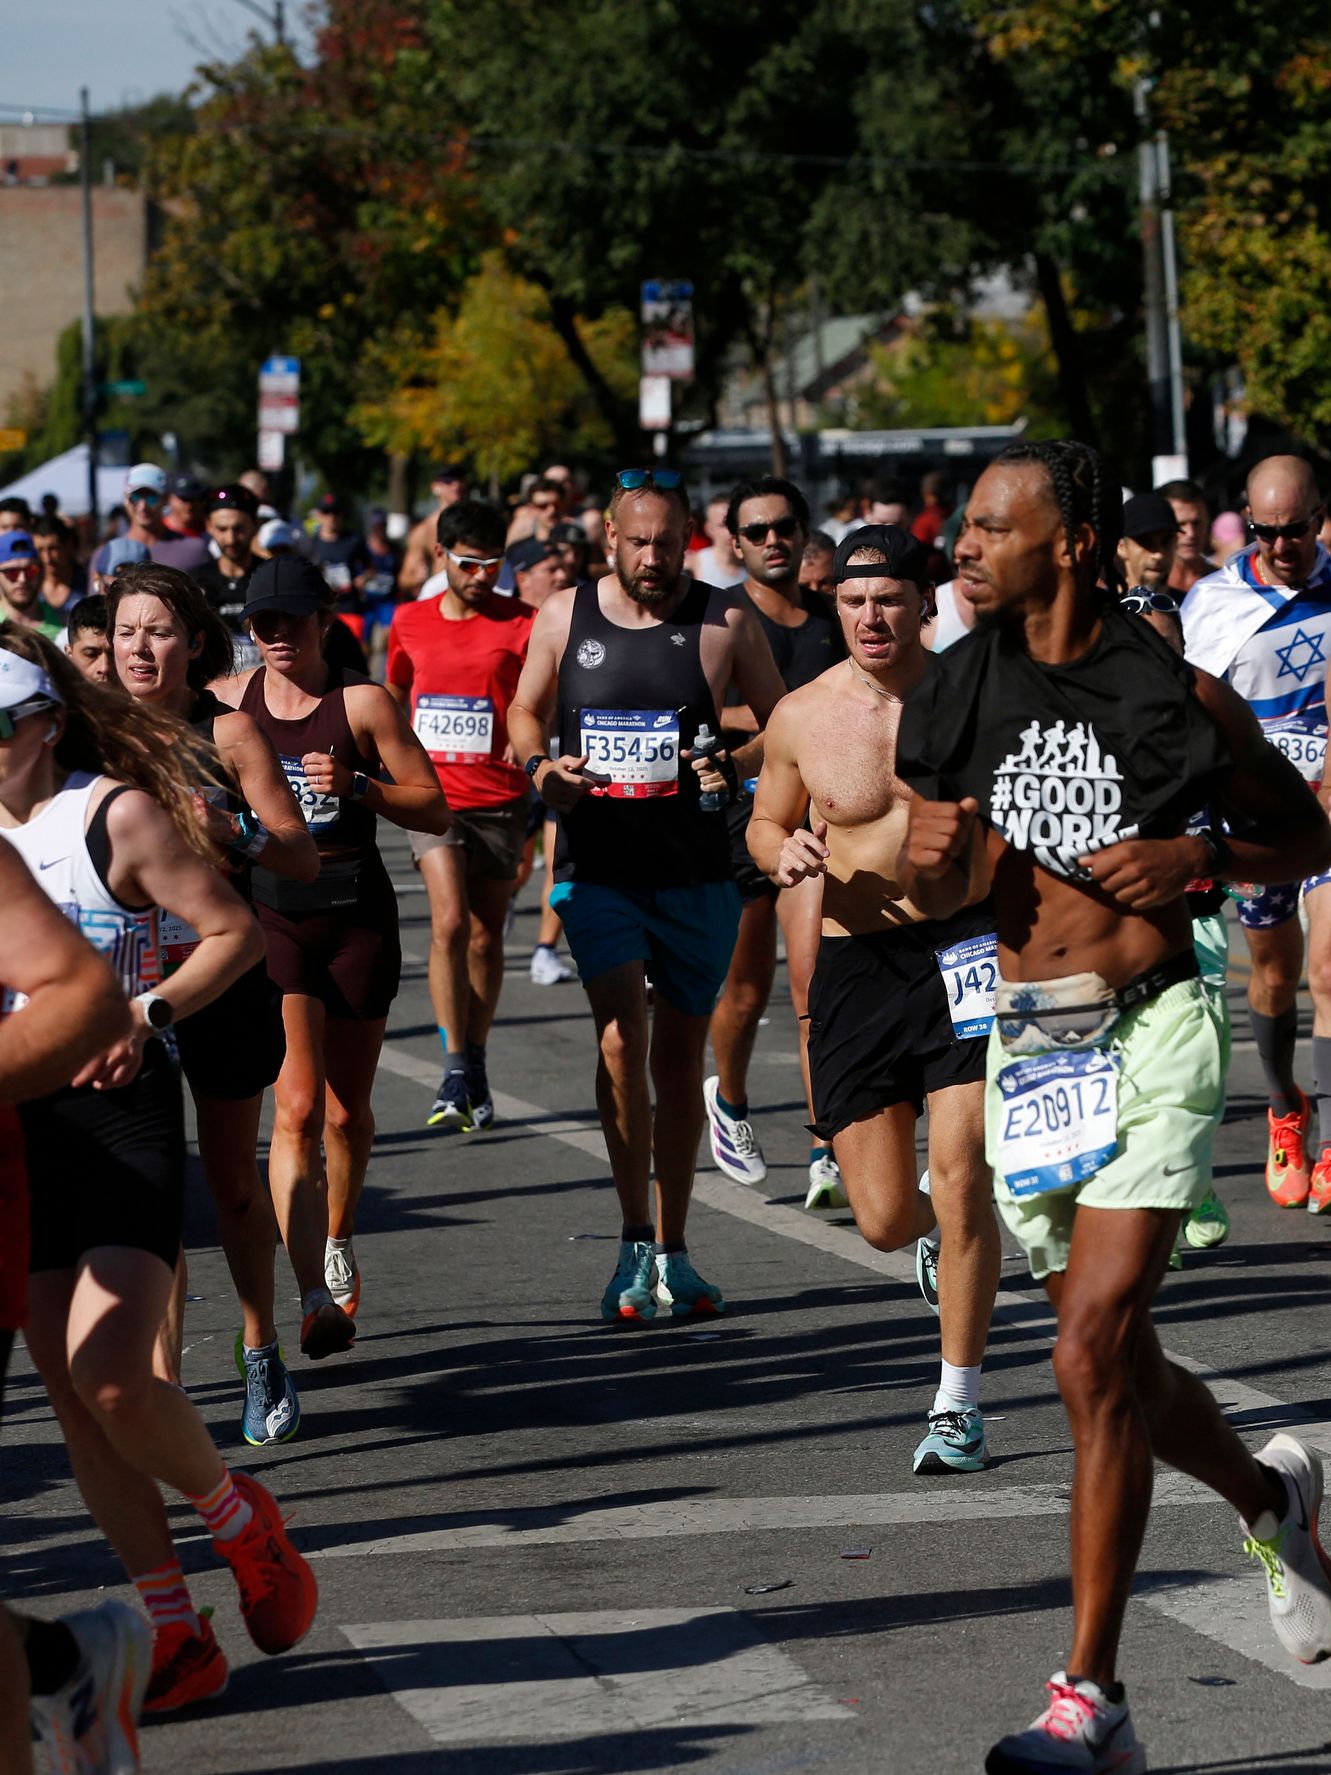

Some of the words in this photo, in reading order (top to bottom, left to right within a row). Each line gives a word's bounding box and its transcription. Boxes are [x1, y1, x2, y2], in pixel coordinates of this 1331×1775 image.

[418, 714, 489, 737] F42698
[596, 719, 618, 727] CHICAGO
[618, 720, 646, 728] MARATHON
[585, 735, 675, 762] F35456
[1266, 737, 1328, 762] 8364
[990, 774, 1122, 815] #GOOD
[991, 809, 1122, 850] WORK
[960, 947, 985, 960] CHICAGO
[952, 962, 999, 1006] J42
[963, 1025, 979, 1033] ROW
[979, 1023, 988, 1032] 38
[1003, 1077, 1111, 1142] E20912
